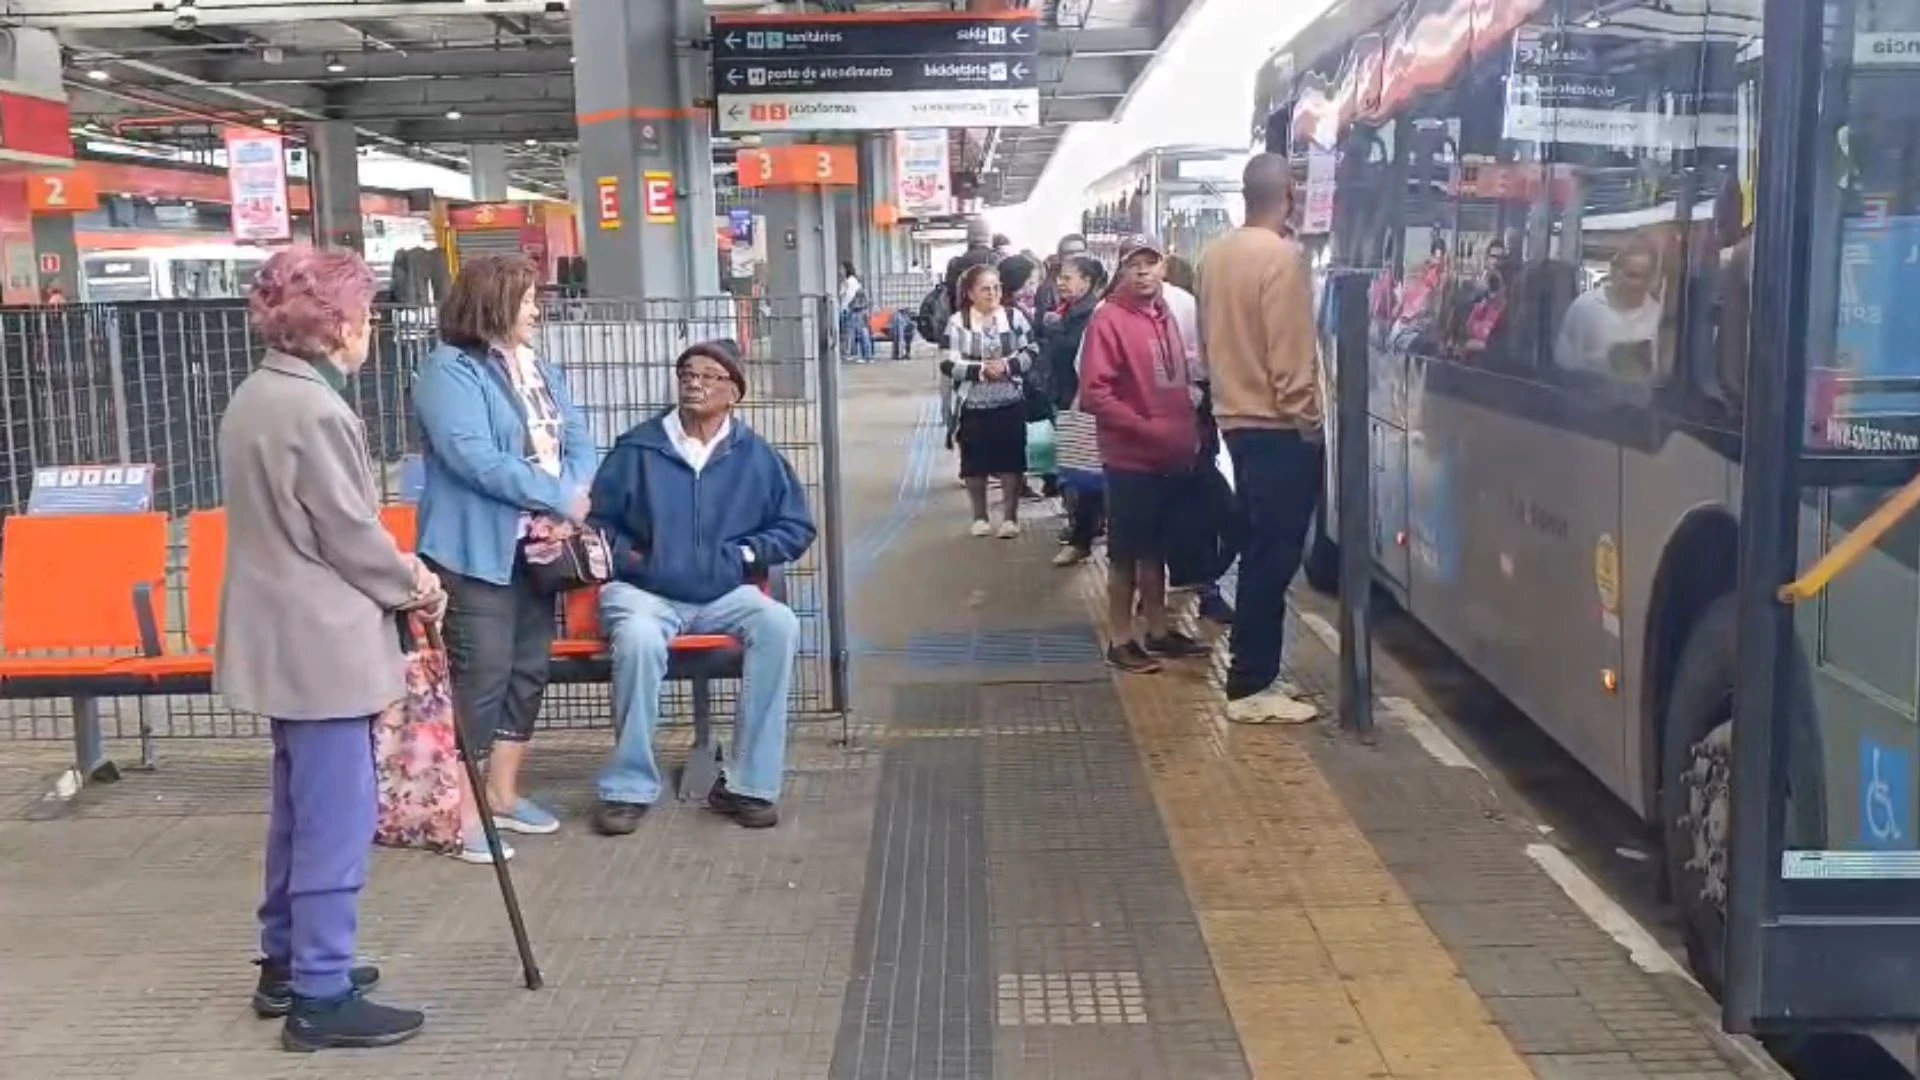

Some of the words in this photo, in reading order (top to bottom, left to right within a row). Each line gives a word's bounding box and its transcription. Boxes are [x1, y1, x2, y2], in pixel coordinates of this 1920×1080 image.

[785, 31, 843, 43] sanitários
[956, 26, 986, 40] saída
[767, 68, 800, 81] posto
[802, 66, 817, 79] de
[820, 66, 894, 79] atendimento
[923, 63, 987, 77] bicicletário
[788, 102, 857, 115] plataformas
[759, 151, 772, 180] 3
[815, 150, 832, 178] 3
[44, 178, 66, 205] 2
[600, 185, 619, 219] E
[648, 180, 672, 214] E
